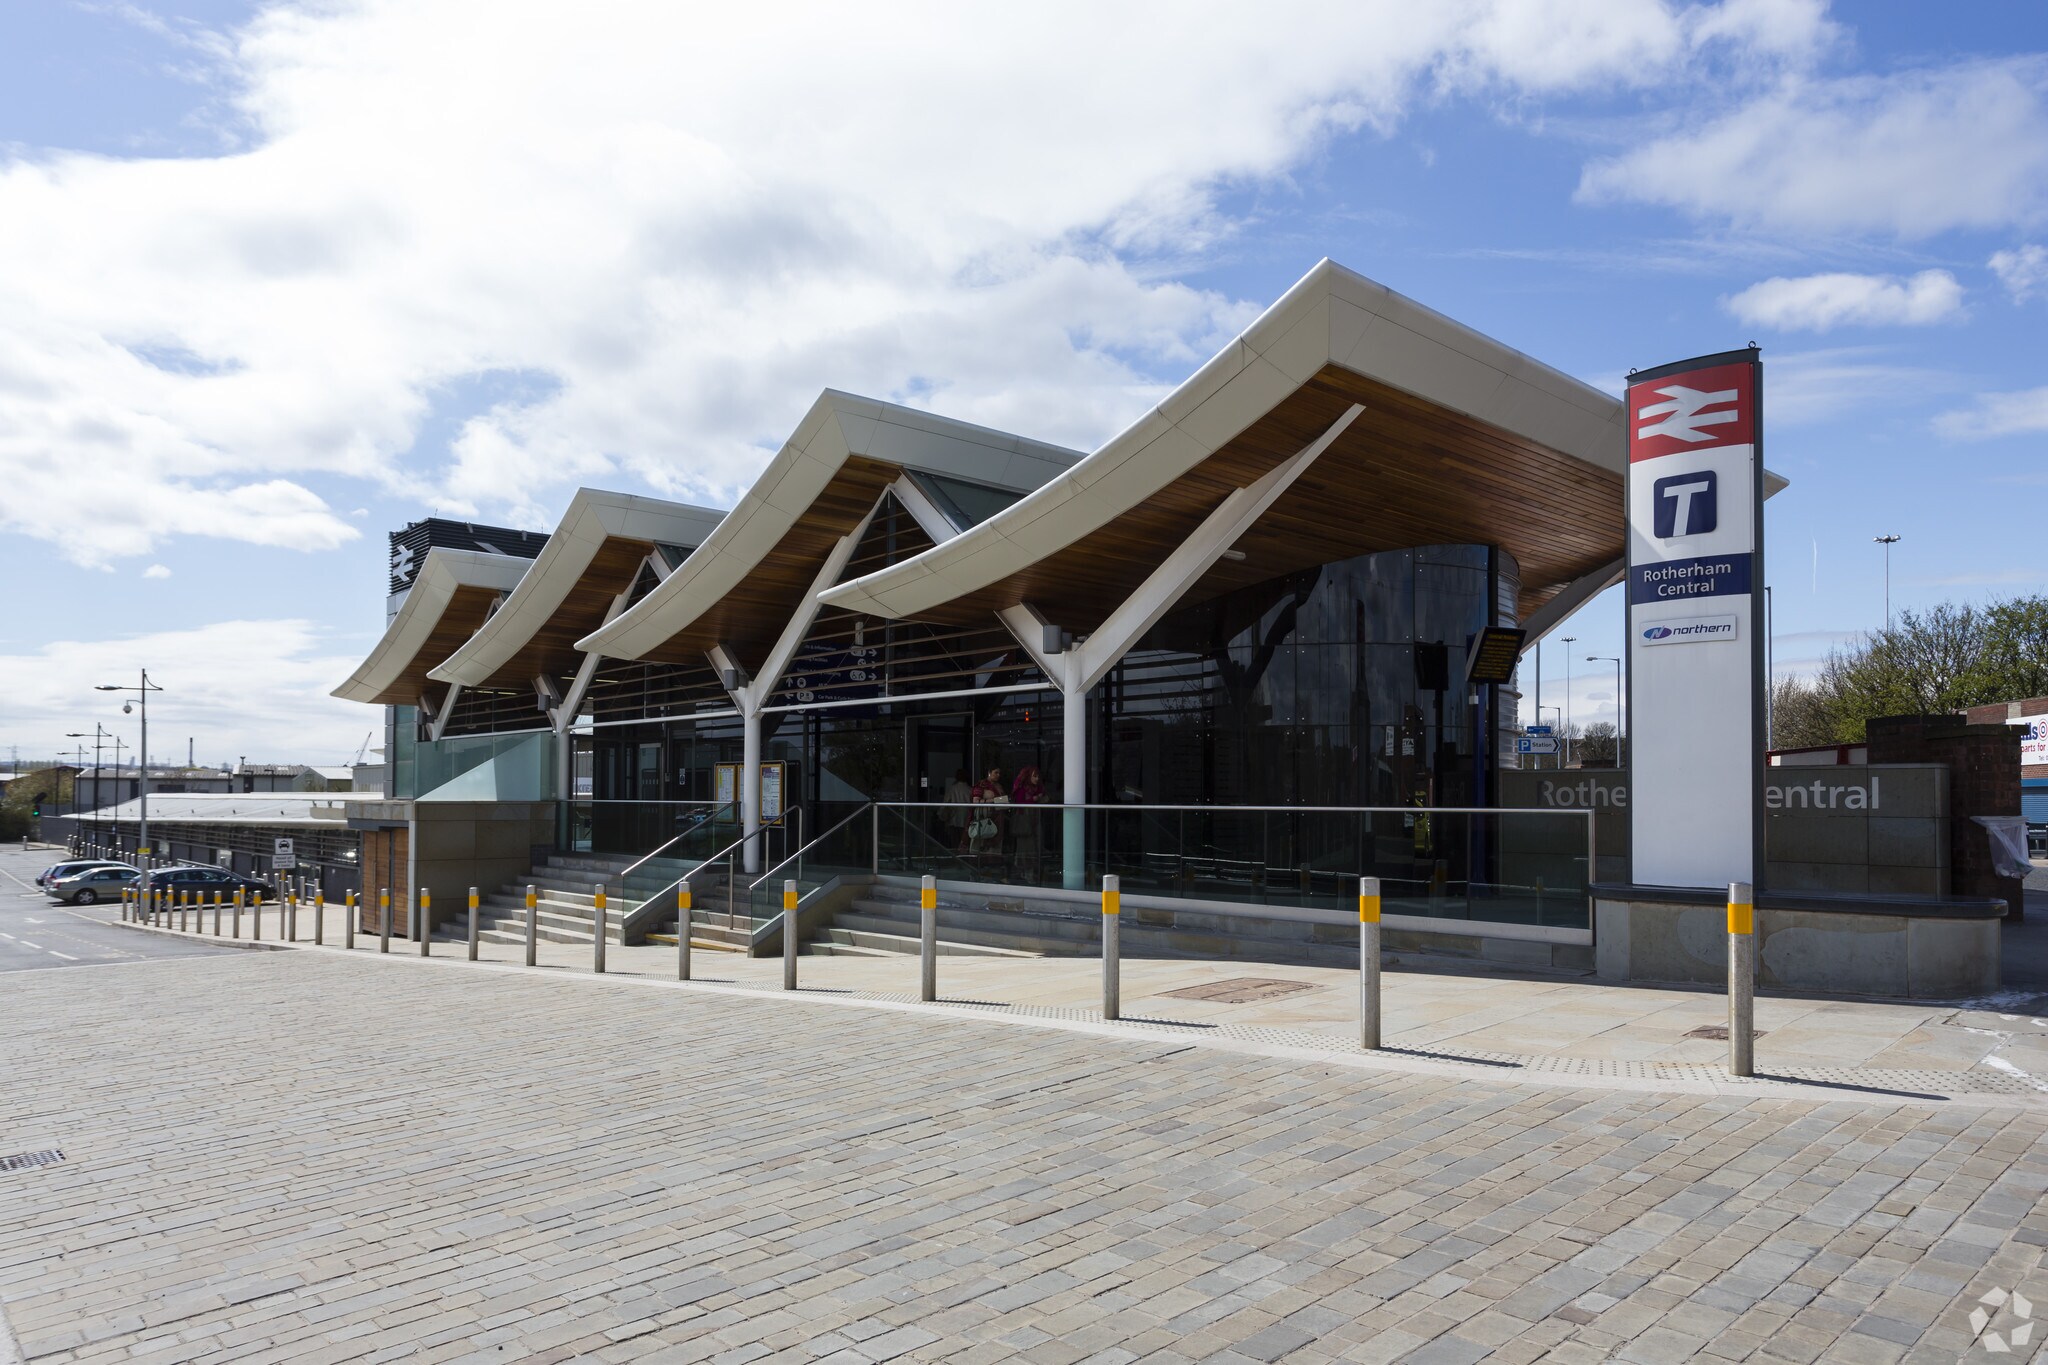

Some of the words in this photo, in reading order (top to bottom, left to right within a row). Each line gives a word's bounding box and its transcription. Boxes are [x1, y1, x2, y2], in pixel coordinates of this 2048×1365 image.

[1663, 480, 1710, 537] T
[1643, 563, 1731, 583] Rotherham
[1657, 578, 1715, 597] Central
[1673, 624, 1731, 635] northern
[1521, 740, 1530, 751] P
[2037, 742, 2046, 752] for
[1765, 776, 1880, 809] entral
